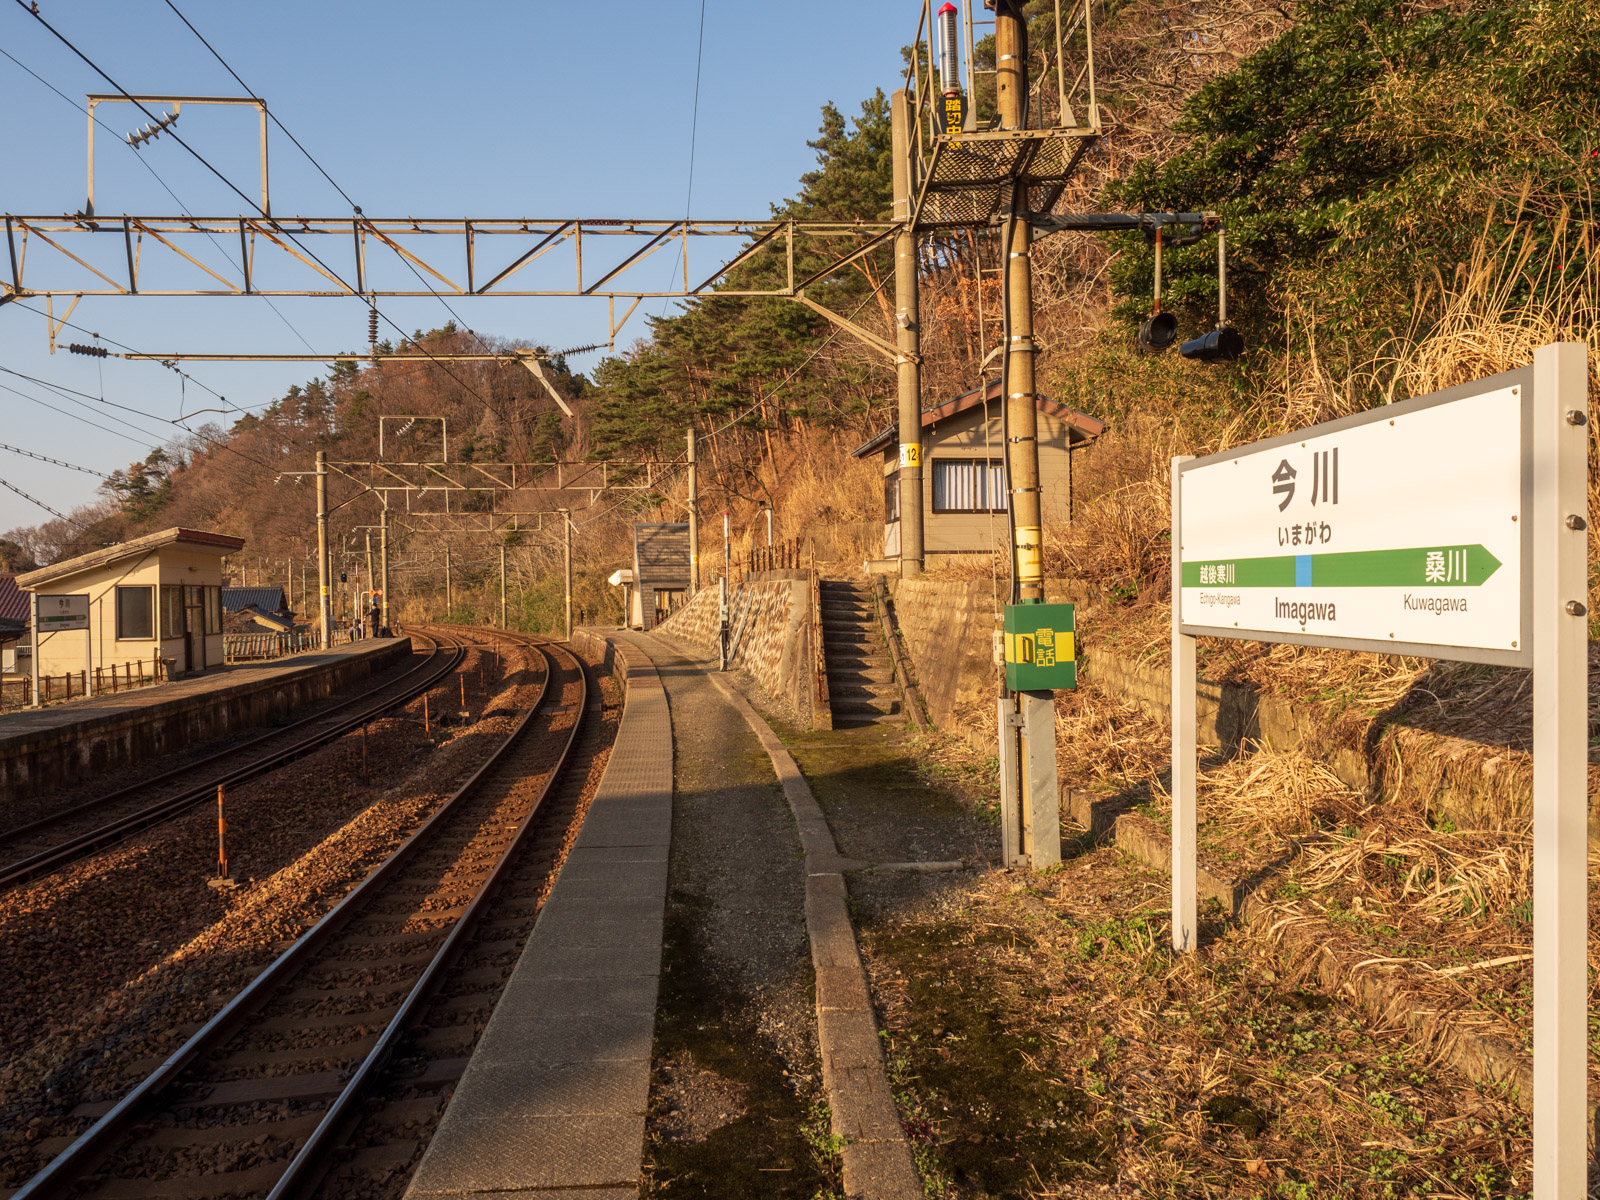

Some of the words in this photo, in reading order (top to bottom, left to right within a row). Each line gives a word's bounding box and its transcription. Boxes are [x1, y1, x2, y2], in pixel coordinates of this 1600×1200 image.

[945, 99, 961, 150] 踏切中
[1272, 447, 1338, 512] 今川
[1278, 521, 1332, 546] いまがわ
[1200, 563, 1235, 584] 越後寒川
[1425, 549, 1467, 583] 桑川
[1274, 597, 1336, 625] Imagawa
[1403, 593, 1468, 615] Kuwagawa
[1035, 628, 1055, 667] 電話
